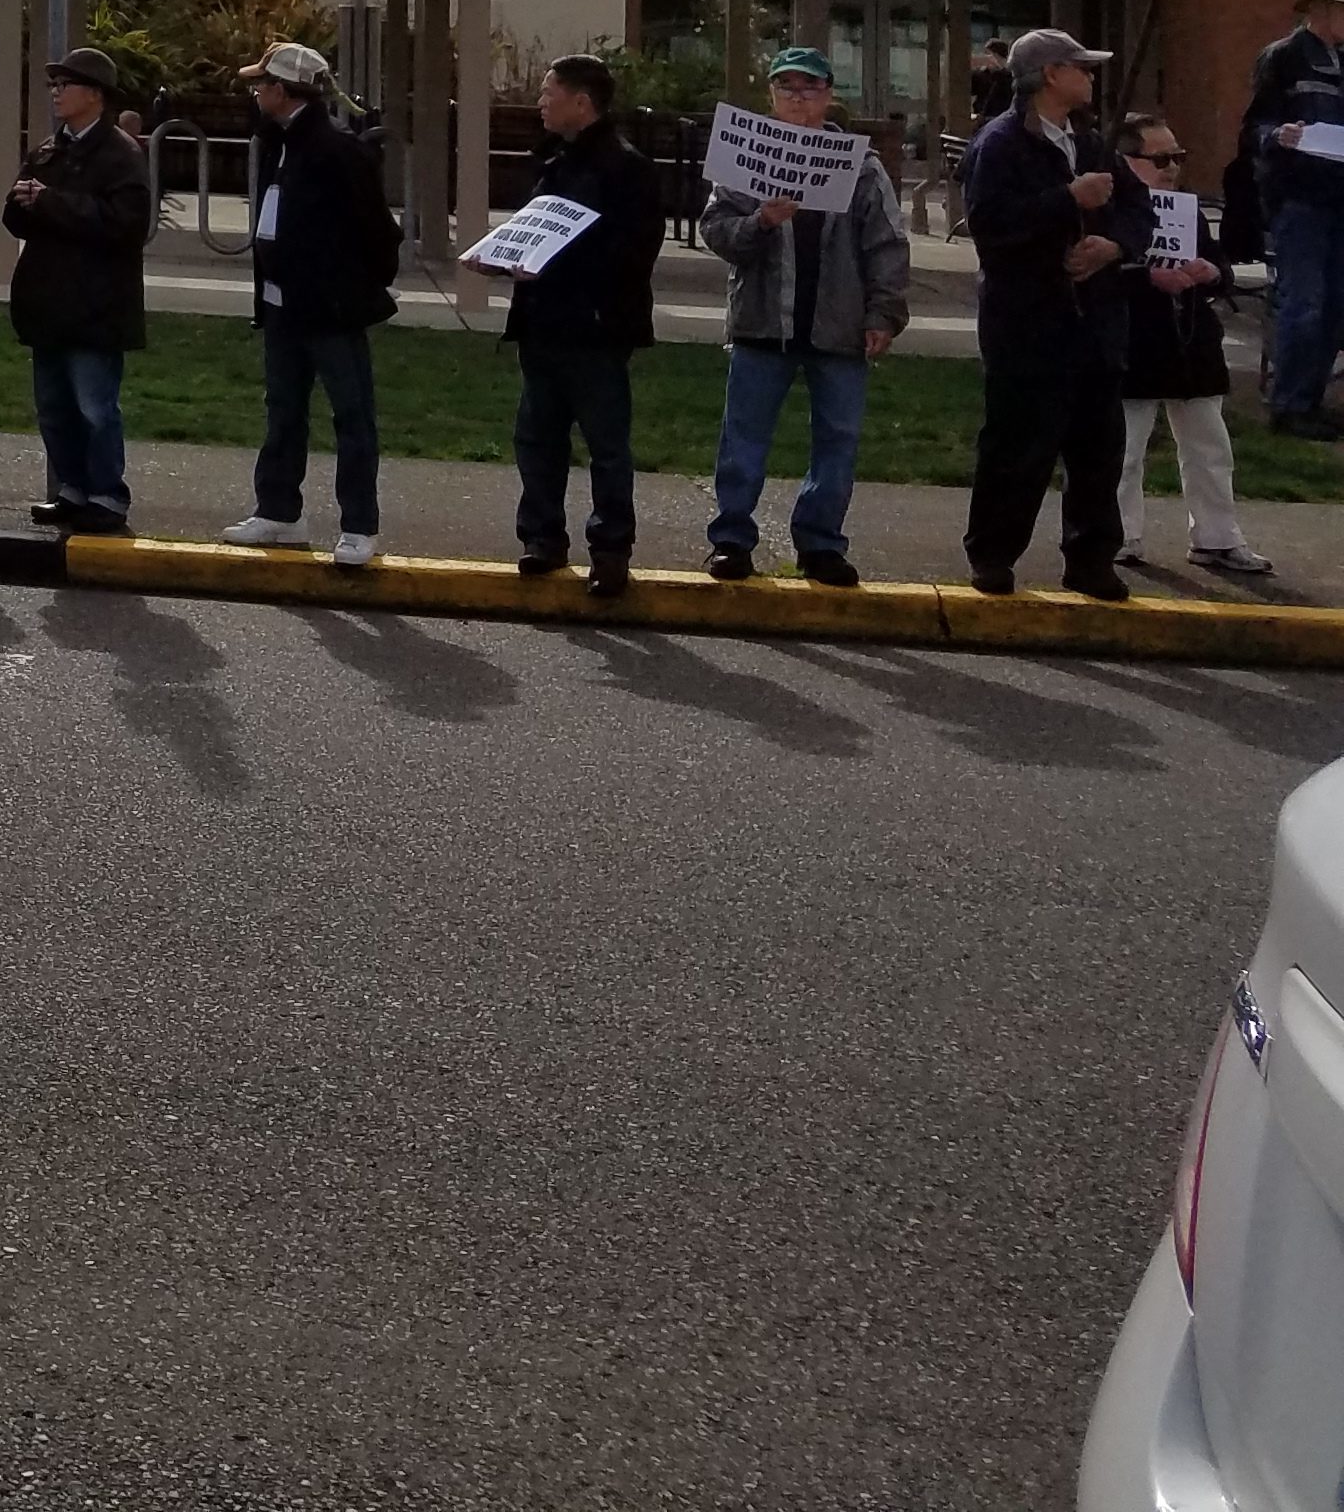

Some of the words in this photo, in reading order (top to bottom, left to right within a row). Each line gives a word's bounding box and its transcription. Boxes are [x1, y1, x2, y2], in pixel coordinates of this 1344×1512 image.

[729, 112, 753, 132] Let
[756, 121, 798, 144] them
[801, 135, 855, 153] offend
[720, 130, 746, 148] our
[748, 138, 783, 161] Lord
[785, 150, 807, 165] no
[809, 156, 854, 171] more.
[736, 153, 767, 175] OUR
[769, 165, 808, 185] LADY
[810, 173, 831, 187] OF
[749, 177, 805, 203] FATIMA
[545, 201, 586, 222] offend
[510, 229, 535, 246] LADY
[531, 233, 547, 247] OF
[539, 218, 573, 238] more.
[490, 245, 525, 263] FATIMA
